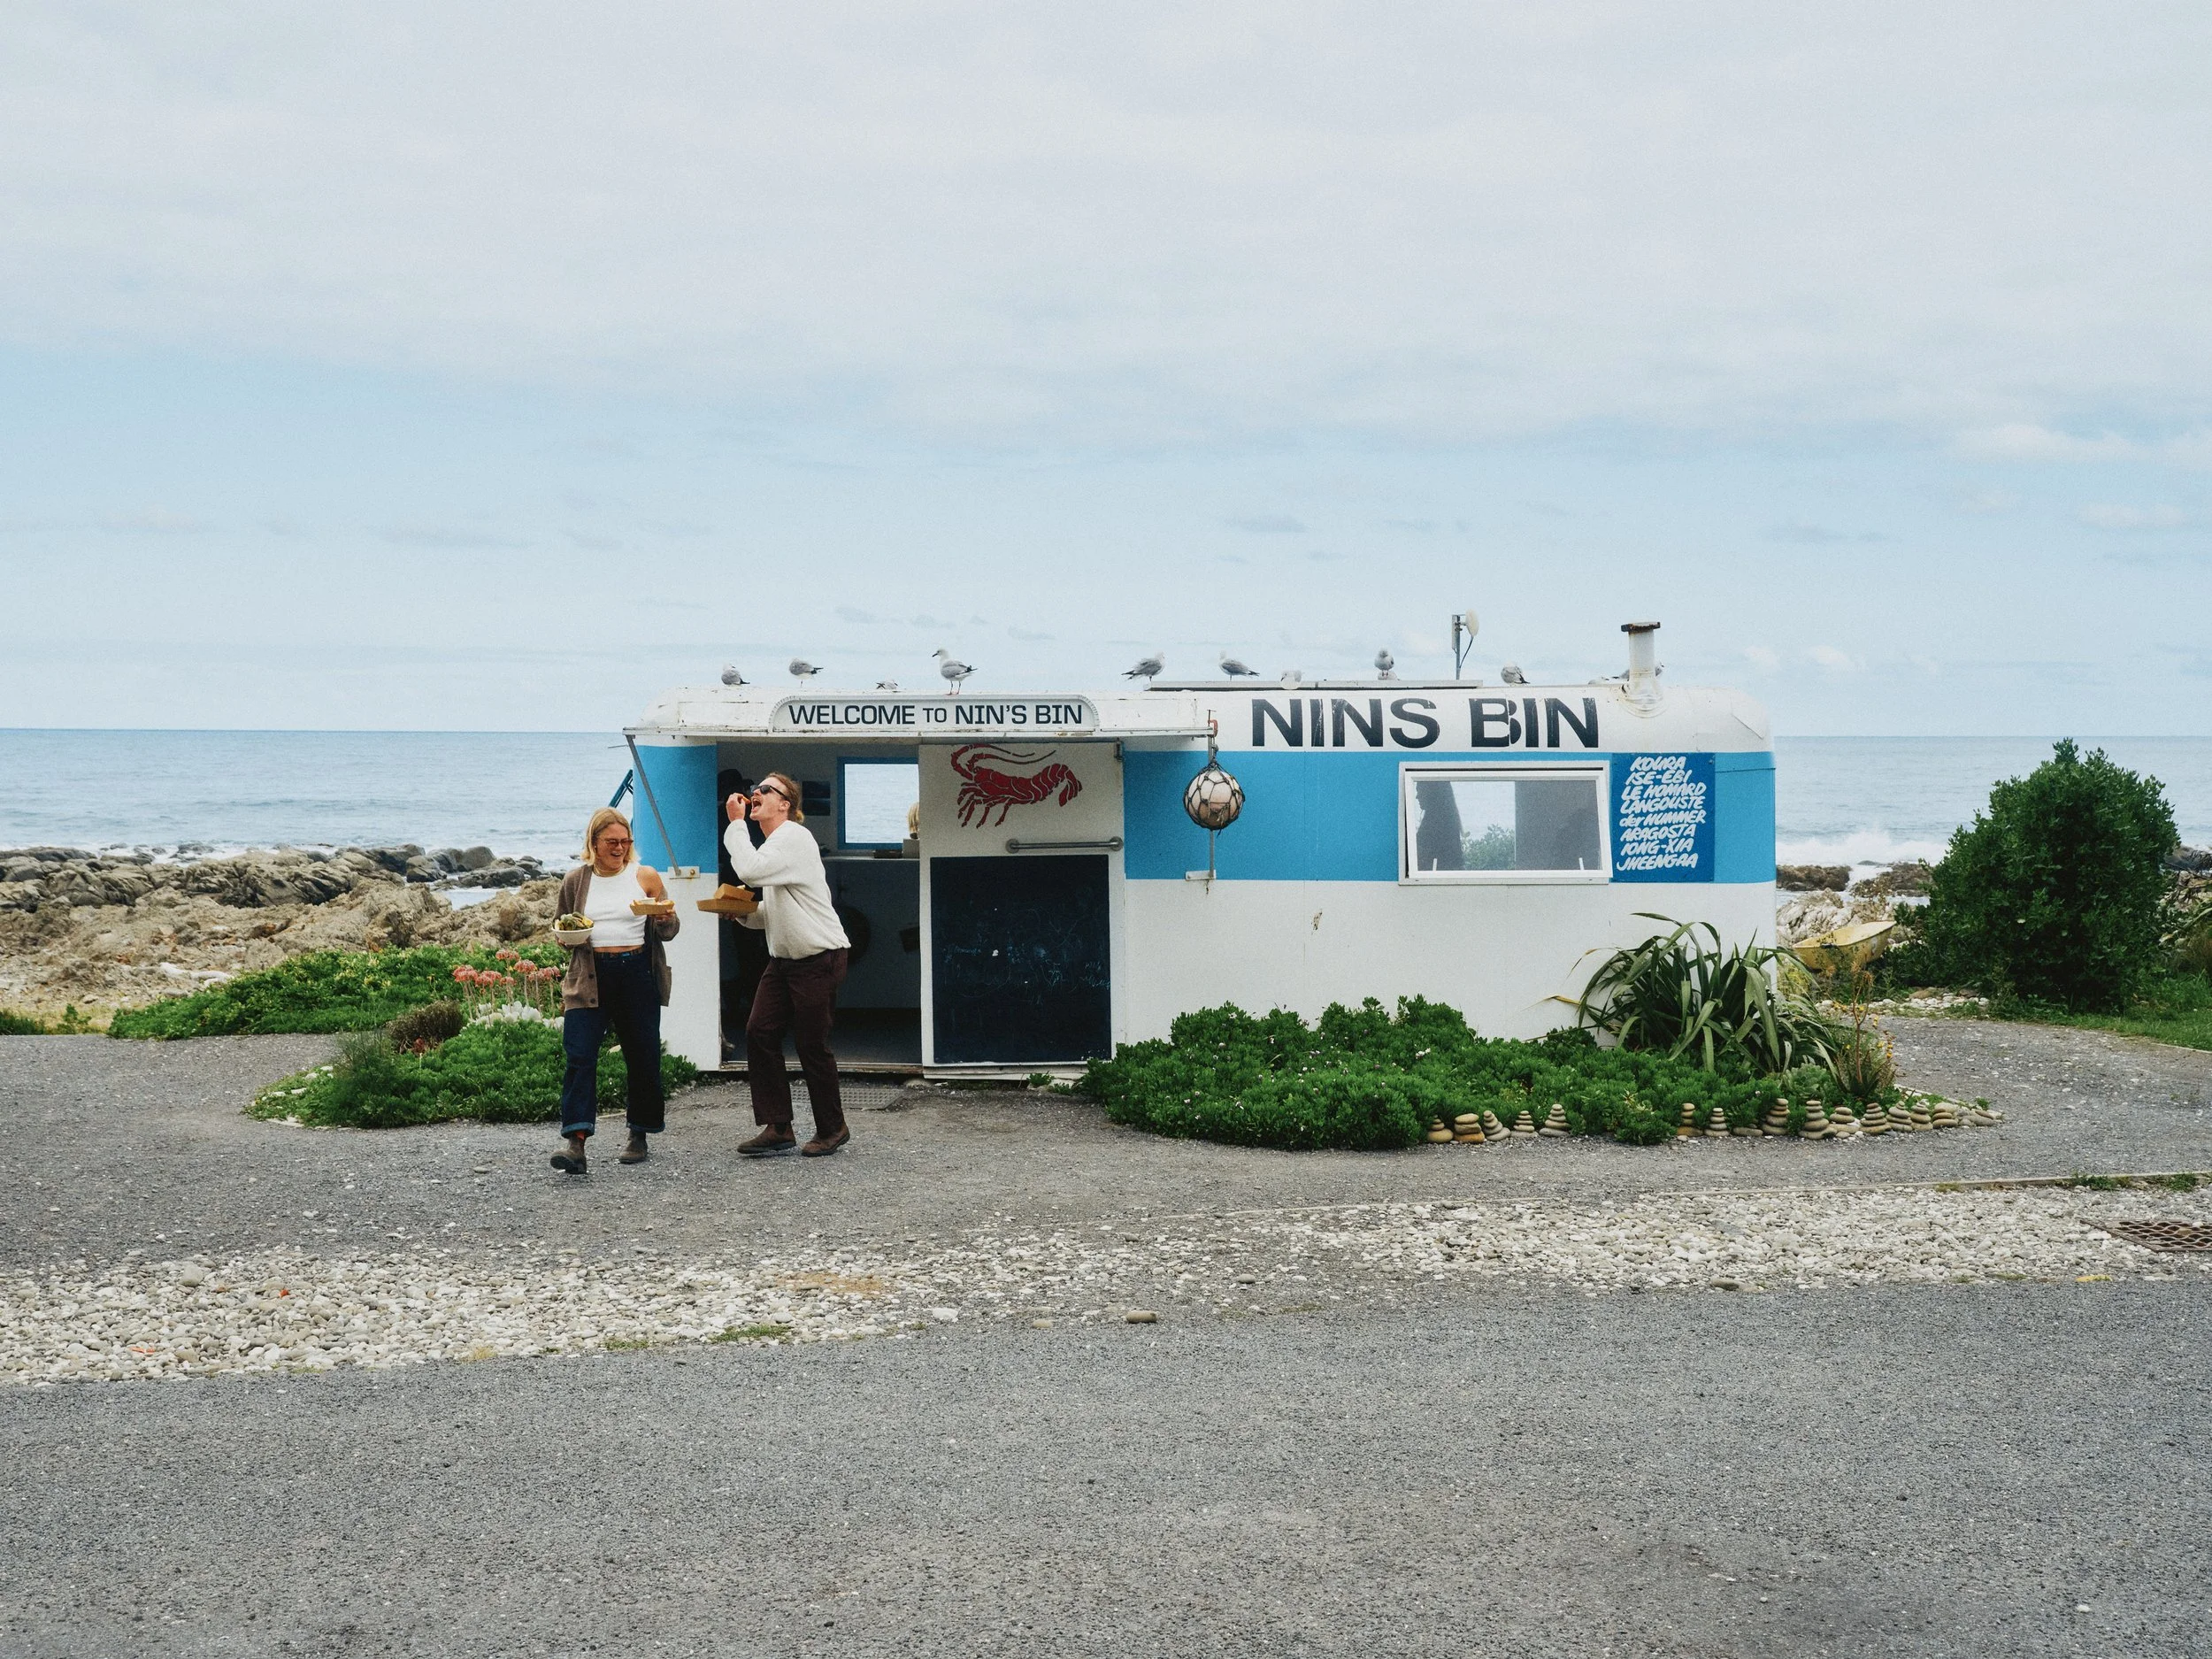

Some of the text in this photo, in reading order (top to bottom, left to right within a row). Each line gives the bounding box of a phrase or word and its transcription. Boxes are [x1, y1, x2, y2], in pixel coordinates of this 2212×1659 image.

[787, 704, 1082, 725] WELCOME TO NIN'S BIN
[1252, 697, 1599, 749] NINS BIN
[1630, 757, 1686, 772] KOURA
[1625, 770, 1692, 786] ISE-EBI
[1621, 782, 1707, 801] LE HOMARD
[1620, 796, 1705, 814] LANGOUSTE
[1619, 810, 1707, 827] der HUMMER
[1620, 824, 1696, 841] ARAGOSTA
[1617, 853, 1699, 871] JHEENGAA
